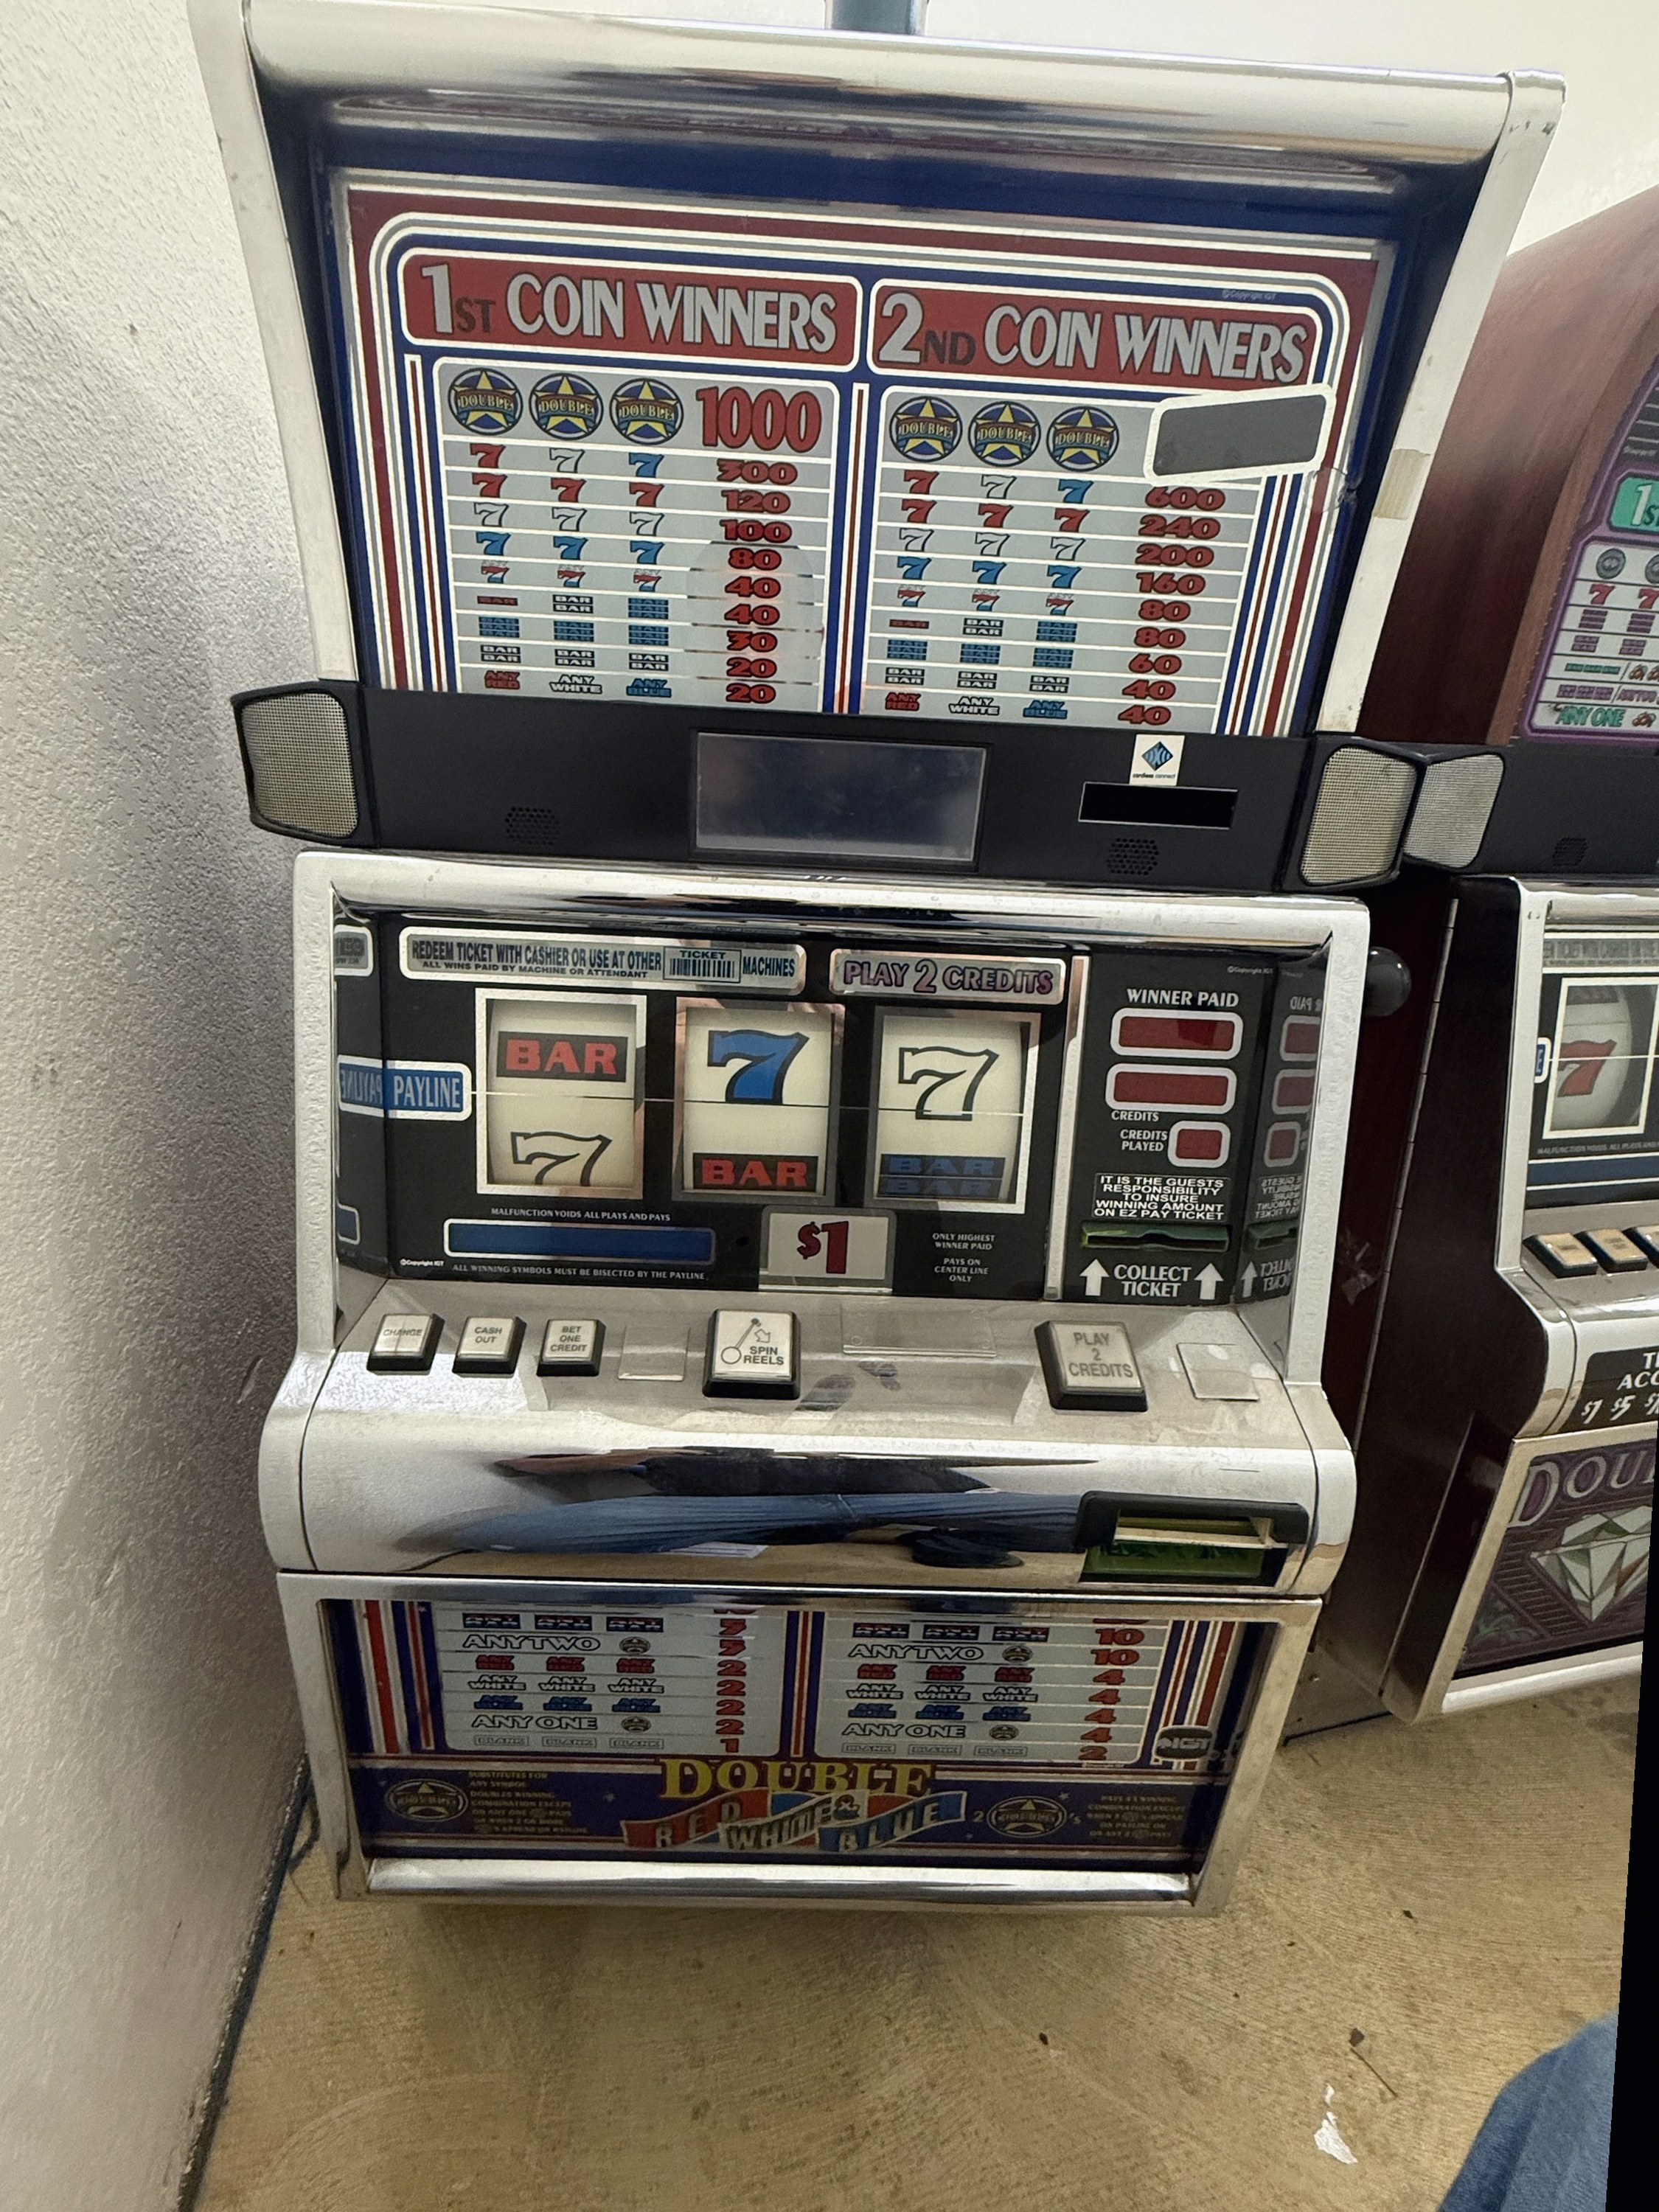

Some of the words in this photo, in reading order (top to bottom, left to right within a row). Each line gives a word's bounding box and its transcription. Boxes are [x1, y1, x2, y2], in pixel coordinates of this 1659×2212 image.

[422, 263, 495, 335] 1ST
[507, 274, 625, 340] COIN
[636, 280, 836, 352] WINNERS
[878, 292, 976, 366] 2ND
[984, 305, 1101, 369] COIN
[1114, 313, 1307, 384] WINNERS
[458, 394, 512, 411] DOUBLE
[540, 399, 594, 416] DOUBLE
[621, 404, 674, 420] DOUBLE
[696, 386, 822, 452] 1000
[898, 422, 952, 438] DOUBLE
[976, 427, 1031, 443] DOUBLE
[1054, 432, 1109, 448] DOUBLE
[470, 442, 506, 468] 7
[549, 448, 585, 473] 7
[629, 453, 664, 478] 7
[717, 459, 798, 485] 300
[903, 470, 939, 494] 7
[981, 474, 1017, 499] 7
[1058, 479, 1094, 504] 7
[1145, 487, 1225, 511] 600
[720, 490, 791, 514] 120
[720, 519, 792, 543] 100
[1138, 514, 1220, 539] 240
[728, 547, 782, 571] 80
[1135, 543, 1214, 567] 200
[725, 576, 781, 598] 40
[1135, 572, 1206, 595] 160
[1138, 599, 1191, 622] 80
[727, 630, 778, 652] 30
[1129, 653, 1182, 675] 60
[559, 674, 594, 684] ANY
[550, 683, 602, 694] WHITE
[726, 683, 776, 704] 20
[959, 696, 994, 706] ANY
[949, 704, 999, 716] WHITE
[1118, 705, 1172, 726] 40
[413, 939, 453, 959] REDEEM
[457, 942, 493, 962] TICKET
[496, 944, 522, 964] WITH
[525, 945, 568, 966] CASHIER
[571, 947, 586, 967] OR
[590, 949, 608, 968] USE
[612, 950, 626, 969] AT
[627, 951, 661, 971] OTHER
[680, 950, 726, 960] TICKET
[742, 956, 795, 977] MACHINES
[501, 964, 515, 973] BY
[518, 966, 566, 975] MACHINE
[587, 969, 647, 978] ATTENDANT
[844, 961, 908, 987] PLAY
[914, 959, 938, 993] 2
[943, 965, 1054, 995] CREDITS
[1127, 989, 1192, 1006] WINNER
[1197, 992, 1239, 1007] PAID
[506, 1038, 617, 1075] BAR
[708, 1029, 809, 1105] 7
[899, 1046, 999, 1121] 7
[394, 1074, 461, 1108] PAYLINE
[1111, 1110, 1159, 1121] CREDITS
[1120, 1129, 1168, 1141] CREDITS
[1121, 1141, 1164, 1152] PLAYED
[511, 1132, 612, 1186] 7
[701, 1158, 807, 1186] BAR
[888, 1157, 995, 1175] BAR
[1100, 1175, 1113, 1184] IT
[1116, 1176, 1130, 1185] IS
[1134, 1177, 1162, 1186] THE
[1166, 1178, 1224, 1188] GUESTS
[1103, 1184, 1220, 1196] RESPONSIBILITY
[1123, 1192, 1142, 1201] TO
[1146, 1193, 1199, 1203] INSURE
[1094, 1208, 1114, 1217] ON
[1119, 1209, 1137, 1217] EZ
[1141, 1210, 1170, 1219] PAY
[1174, 1211, 1224, 1220] TICKET
[1096, 1200, 1159, 1210] WINNING
[1163, 1202, 1224, 1212] AMOUNT
[491, 1208, 554, 1218] MALFUNCTION
[555, 1210, 582, 1218] VOIDS
[584, 1211, 599, 1219] ALL
[602, 1211, 627, 1220] PLAYS
[628, 1212, 648, 1220] AND
[649, 1213, 671, 1222] PAYS
[933, 1232, 956, 1242] ONLY
[958, 1233, 995, 1242] HIGHEST
[796, 1220, 849, 1275] $1
[935, 1242, 969, 1250] WINNER
[970, 1242, 992, 1251] PAID
[943, 1257, 965, 1266] PAYS
[967, 1258, 981, 1266] ON
[470, 1265, 510, 1273] WINNING
[512, 1266, 552, 1275] SYMBOLS
[554, 1267, 577, 1276] MUST
[593, 1269, 635, 1277] BISECTED
[934, 1266, 969, 1275] CENTER
[970, 1267, 990, 1275] LINE
[1113, 1264, 1192, 1282] COLLECT
[949, 1275, 973, 1283] ONLY
[1121, 1281, 1182, 1298] TICKET
[383, 1328, 422, 1337] CHANGE
[474, 1326, 502, 1335] CASH
[1074, 1332, 1110, 1346] PLAY
[749, 1346, 778, 1356] SPIN
[1092, 1348, 1102, 1361] 2
[743, 1355, 784, 1366] REELS
[1069, 1363, 1133, 1378] CREDITS
[1507, 1450, 1655, 1528] DOU
[463, 1635, 526, 1649] ANY
[527, 1636, 601, 1651] TWO
[1095, 1628, 1144, 1645] 10
[848, 1644, 913, 1658] ANY
[913, 1645, 984, 1660] TWO
[717, 1660, 746, 1676] 2
[1093, 1669, 1125, 1685] 4
[471, 1714, 533, 1728] ANY
[535, 1716, 597, 1730] ONE
[842, 1722, 904, 1737] ANY
[905, 1724, 966, 1738] ONE
[720, 1738, 740, 1753] 1
[1079, 1745, 1107, 1760] 2
[661, 1758, 936, 1799] DOUBLE
[655, 1800, 742, 1848] RED
